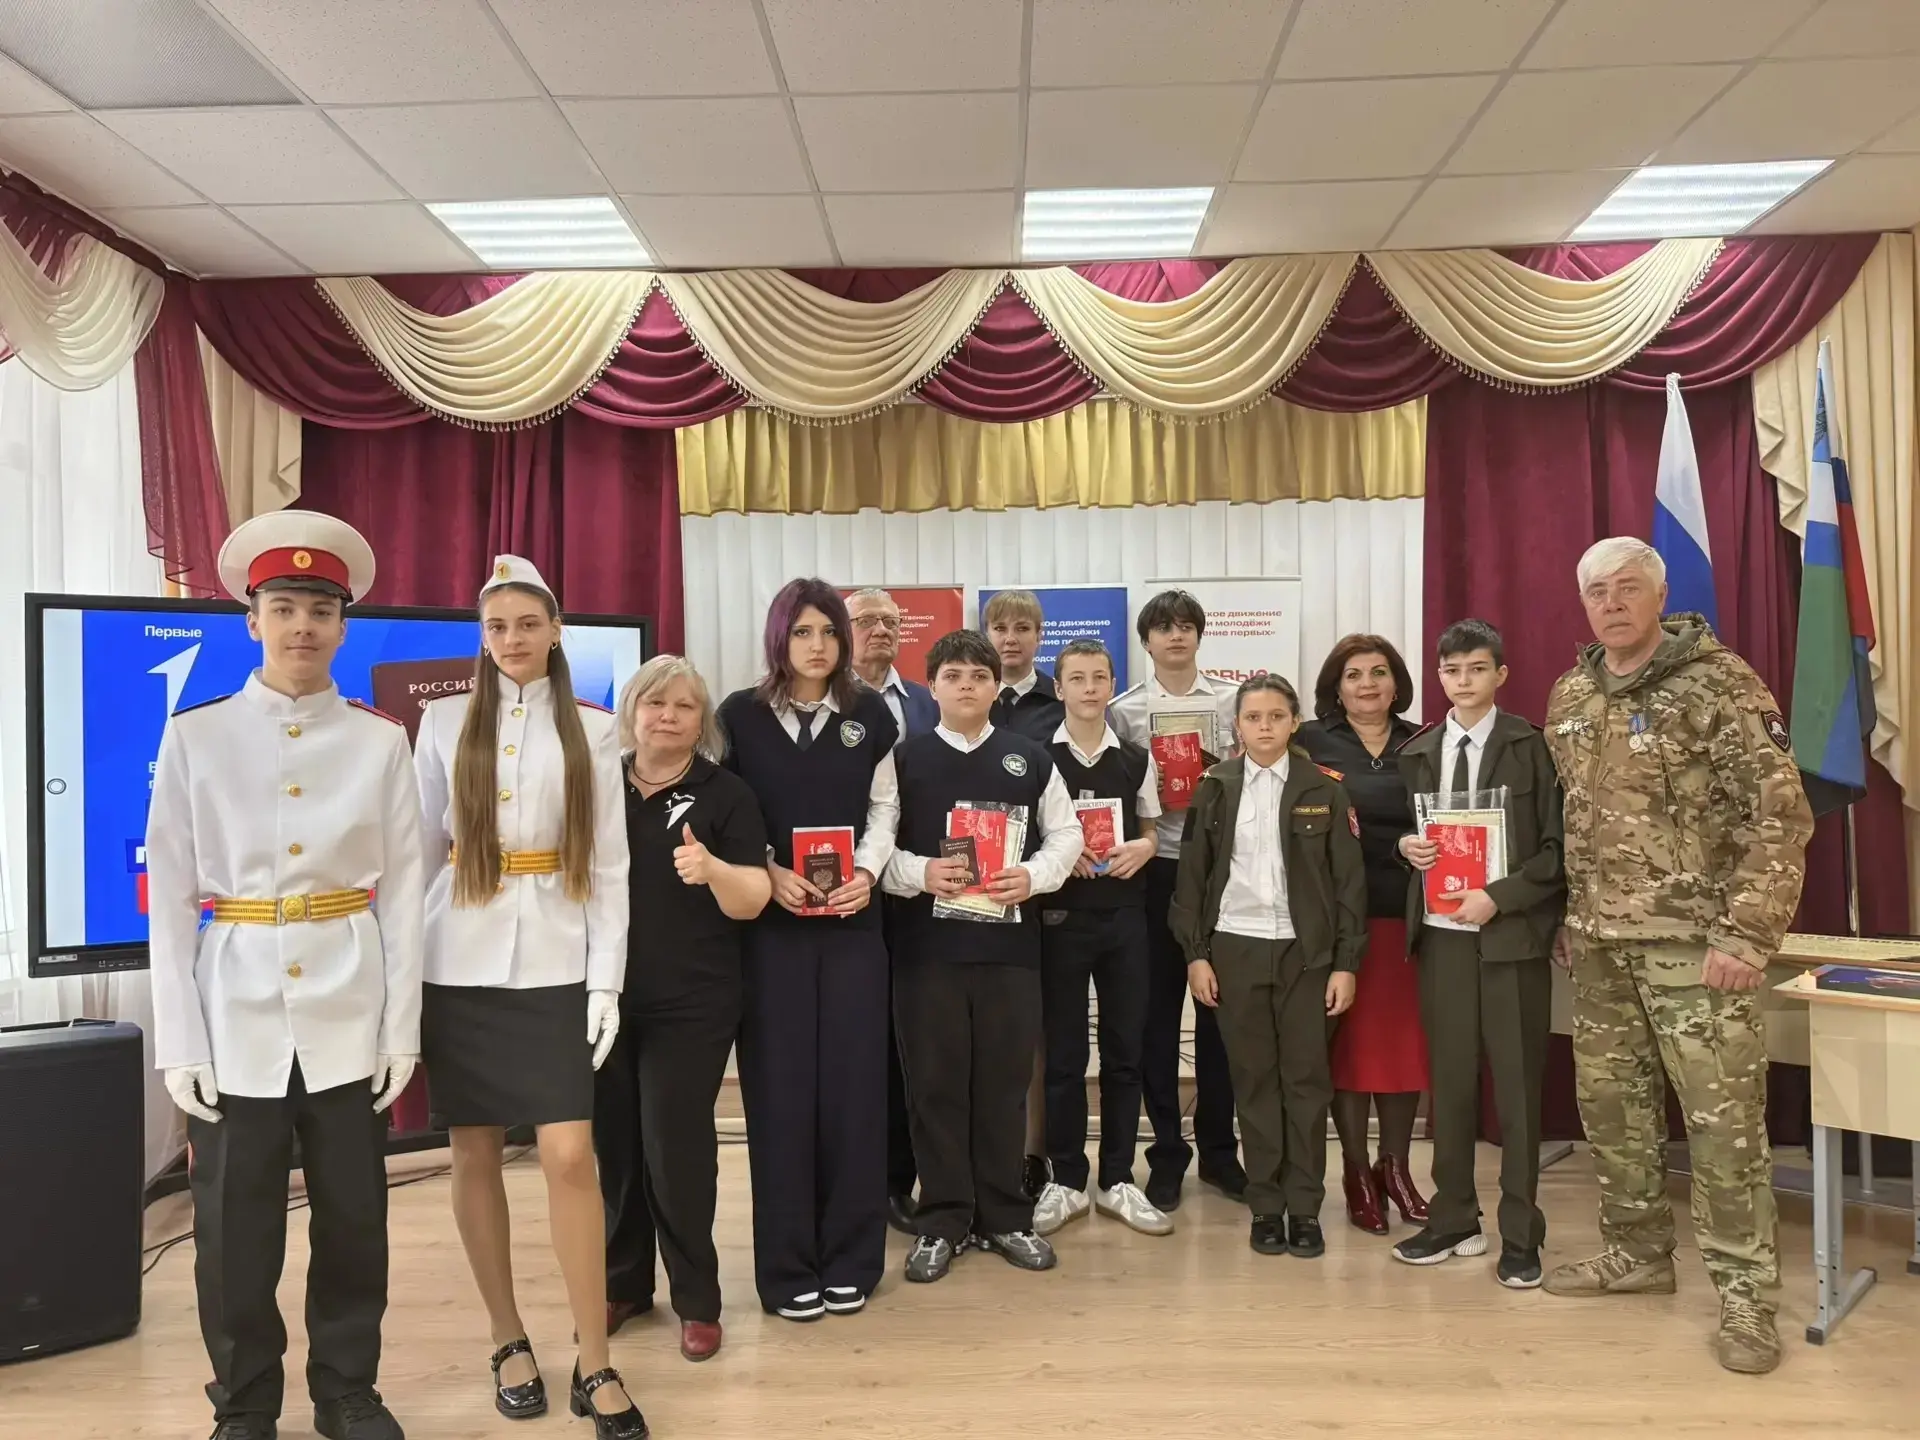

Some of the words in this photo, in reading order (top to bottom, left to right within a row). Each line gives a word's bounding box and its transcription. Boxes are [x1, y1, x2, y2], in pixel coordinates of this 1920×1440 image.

[1058, 620, 1111, 628] движение
[1215, 619, 1271, 627] молодёжи
[145, 625, 203, 640] Первые
[1046, 628, 1100, 637] молодёжи
[1230, 630, 1276, 638] первых»
